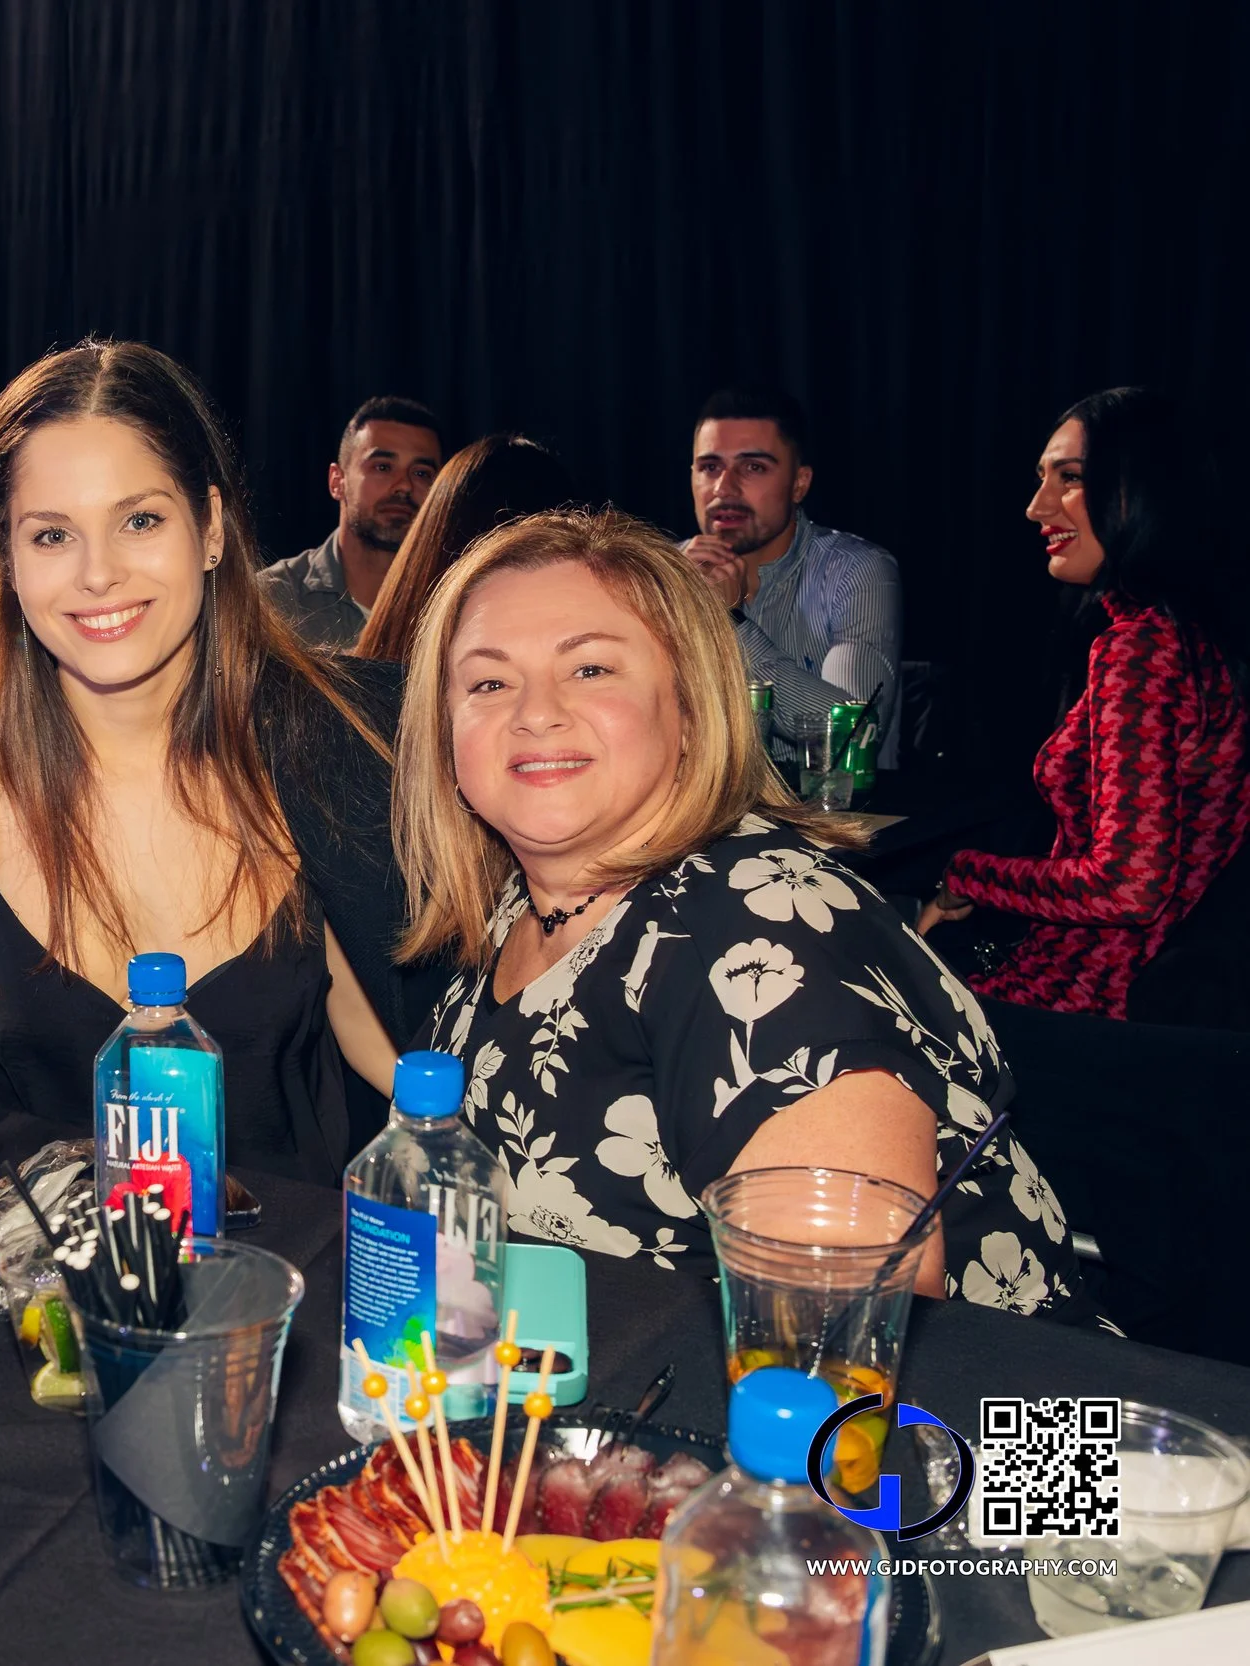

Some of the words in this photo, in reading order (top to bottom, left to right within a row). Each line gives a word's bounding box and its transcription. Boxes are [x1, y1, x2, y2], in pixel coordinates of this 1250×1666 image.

[110, 1089, 127, 1101] From
[129, 1091, 140, 1101] the
[106, 1103, 180, 1163] FIJI
[106, 1160, 130, 1169] NATURAL
[132, 1162, 161, 1171] ARTESIAN
[161, 1163, 182, 1172] WATER
[350, 1216, 410, 1245] FOUNDATION
